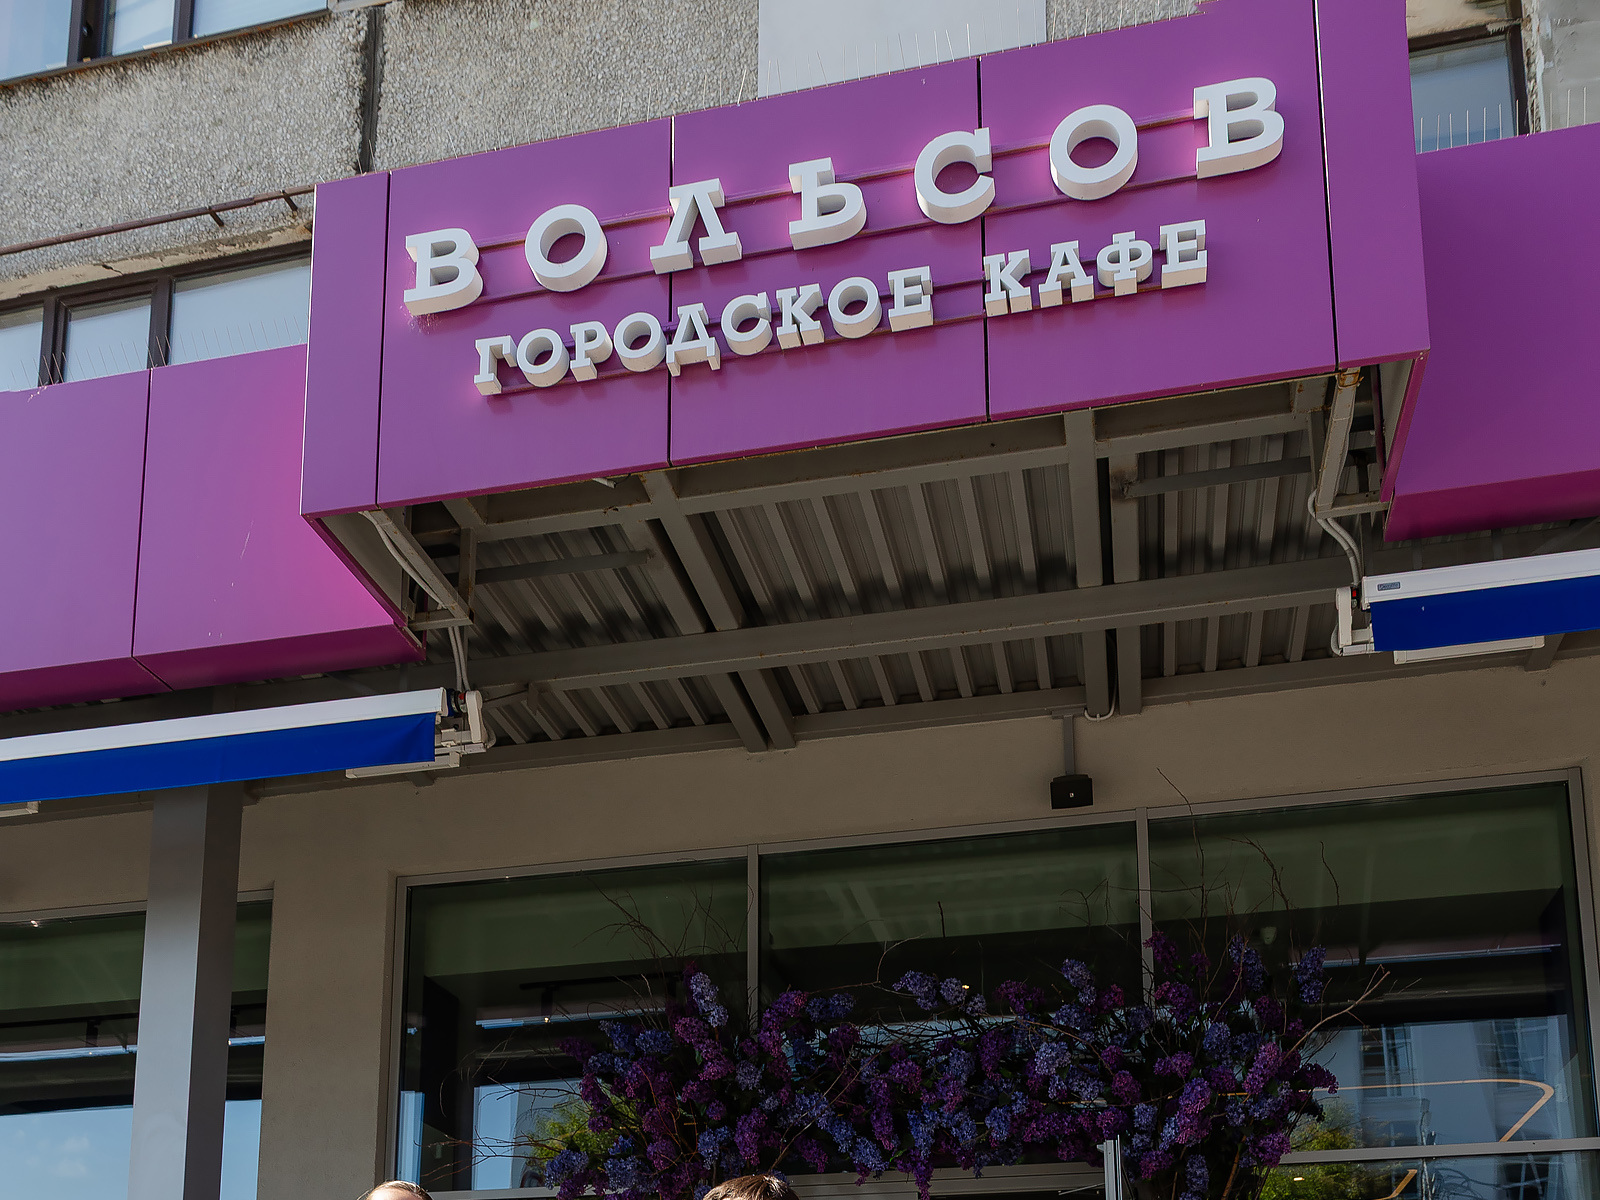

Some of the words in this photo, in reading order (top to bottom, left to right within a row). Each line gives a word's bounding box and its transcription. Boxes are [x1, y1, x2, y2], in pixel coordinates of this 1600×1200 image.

[403, 77, 1285, 317] ВОЛЬСОВ
[474, 265, 934, 395] ГОРОДСКОЕ
[983, 219, 1208, 317] КАФЕ
